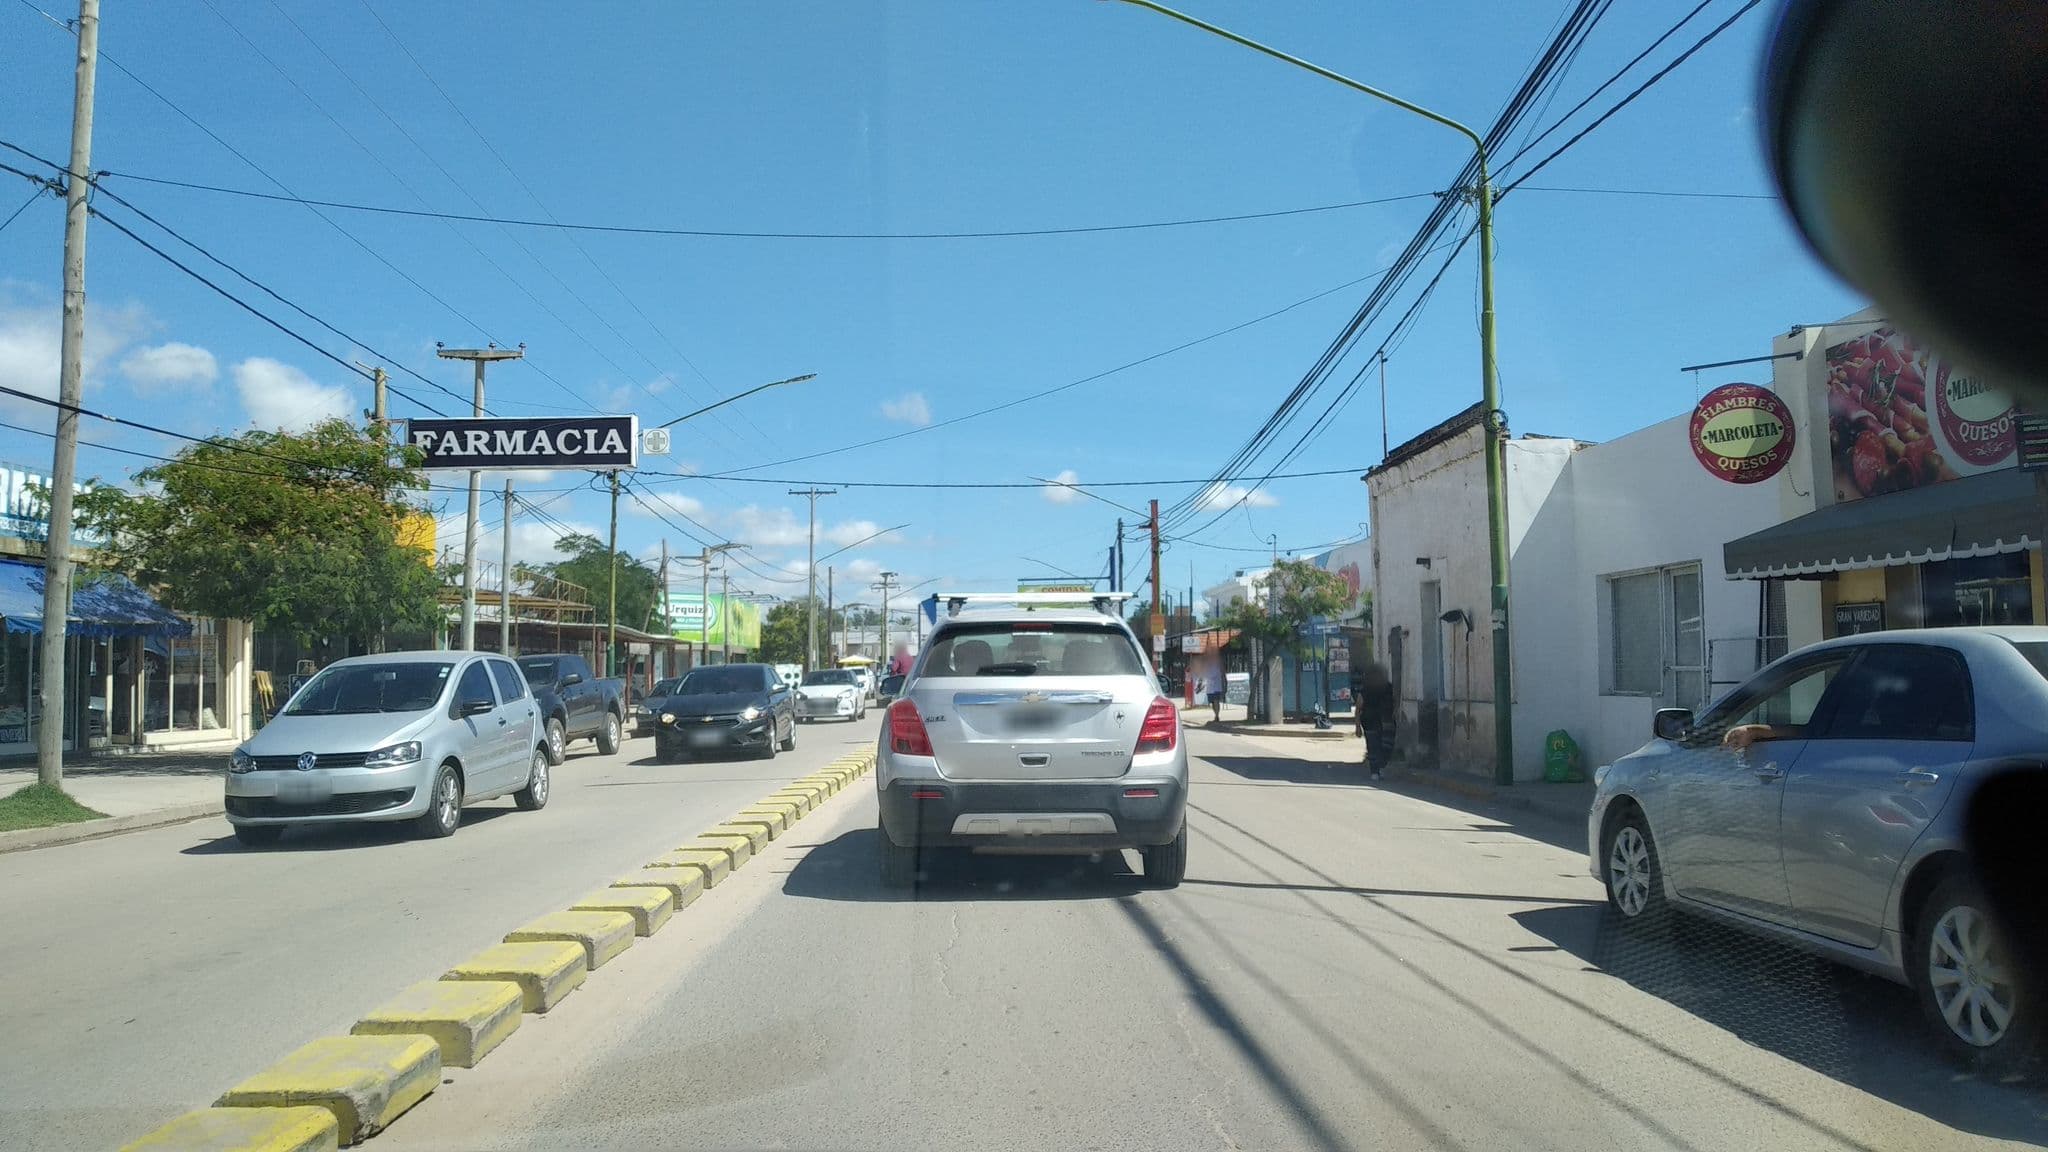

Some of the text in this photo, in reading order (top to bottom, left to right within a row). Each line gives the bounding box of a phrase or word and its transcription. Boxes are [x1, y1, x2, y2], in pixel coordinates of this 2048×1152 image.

[1701, 397, 1777, 421] FIAMBRES
[413, 428, 628, 456] FARMACIA
[1717, 450, 1778, 471] QUESOS
